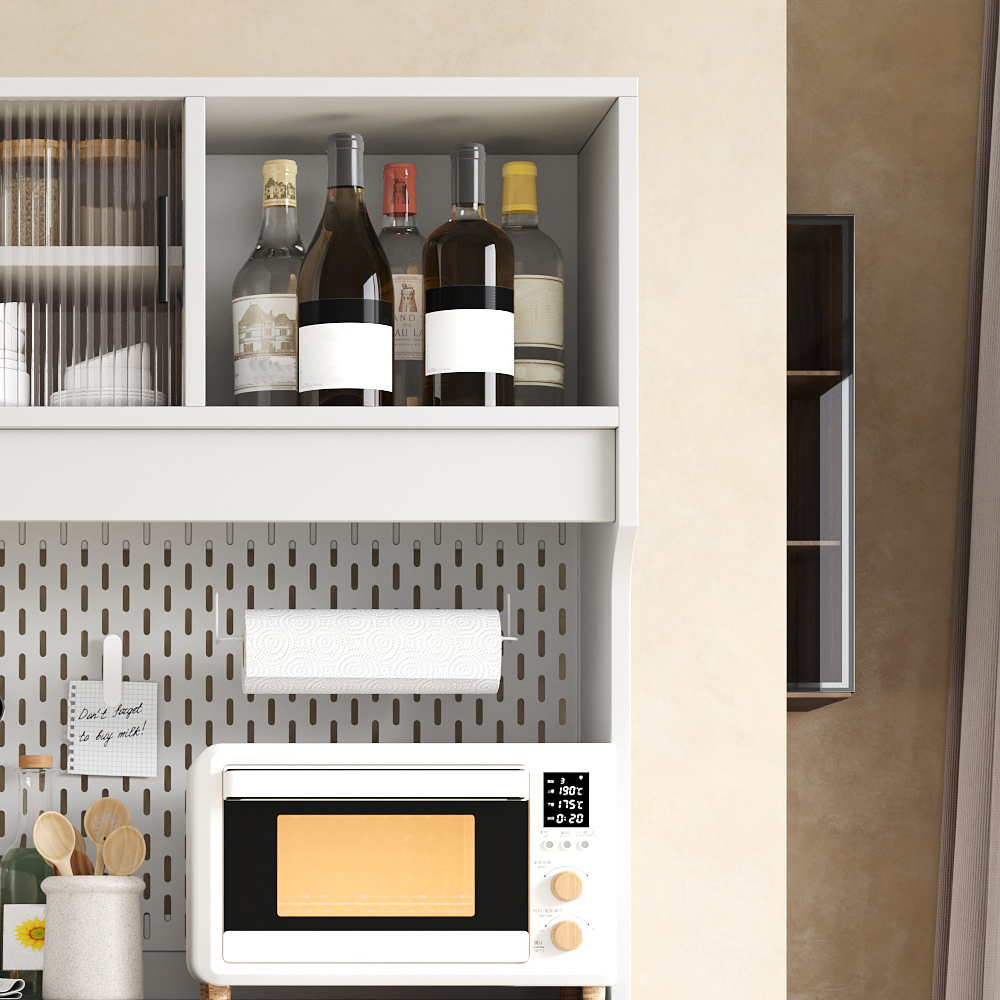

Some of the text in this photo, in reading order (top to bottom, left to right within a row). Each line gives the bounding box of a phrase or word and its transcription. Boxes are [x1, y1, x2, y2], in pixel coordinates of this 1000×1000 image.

[78, 702, 143, 720] Don't forget
[78, 720, 147, 747] to buy milk!
